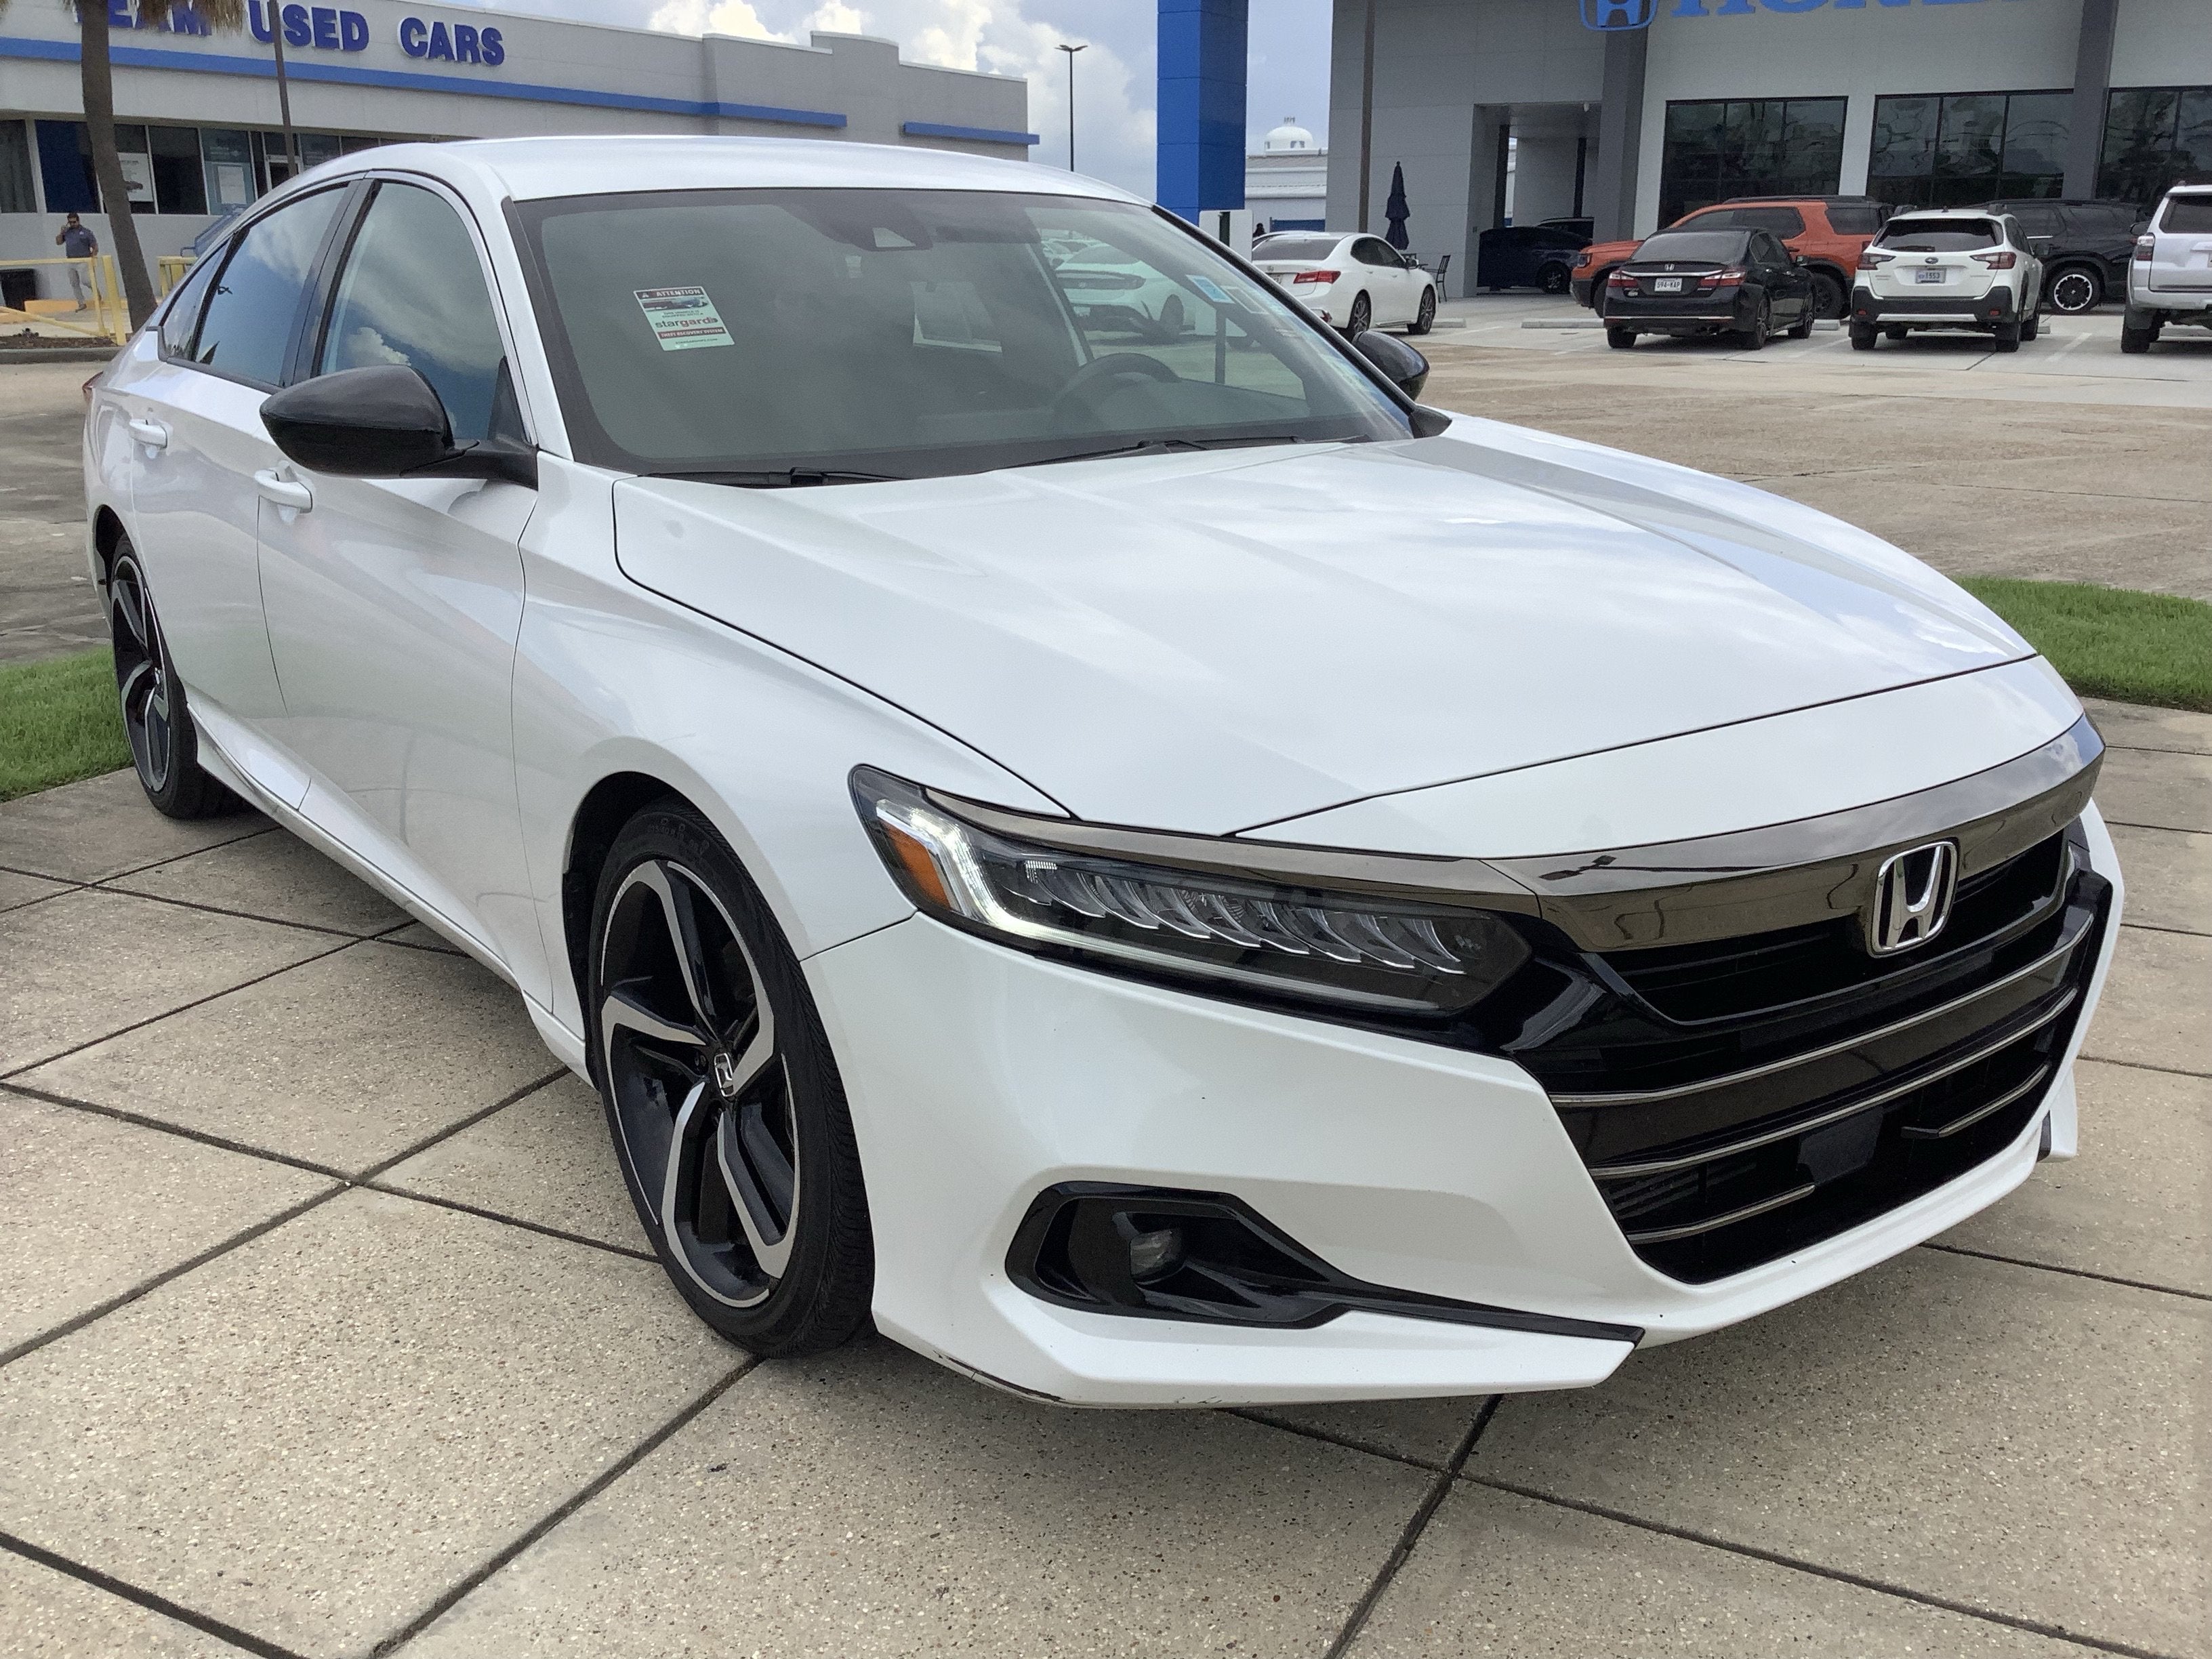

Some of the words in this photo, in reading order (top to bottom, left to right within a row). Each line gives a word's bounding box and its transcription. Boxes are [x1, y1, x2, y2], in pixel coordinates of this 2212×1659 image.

[247, 0, 369, 52] USED
[398, 17, 506, 66] CARS
[656, 289, 701, 297] ATTENTION
